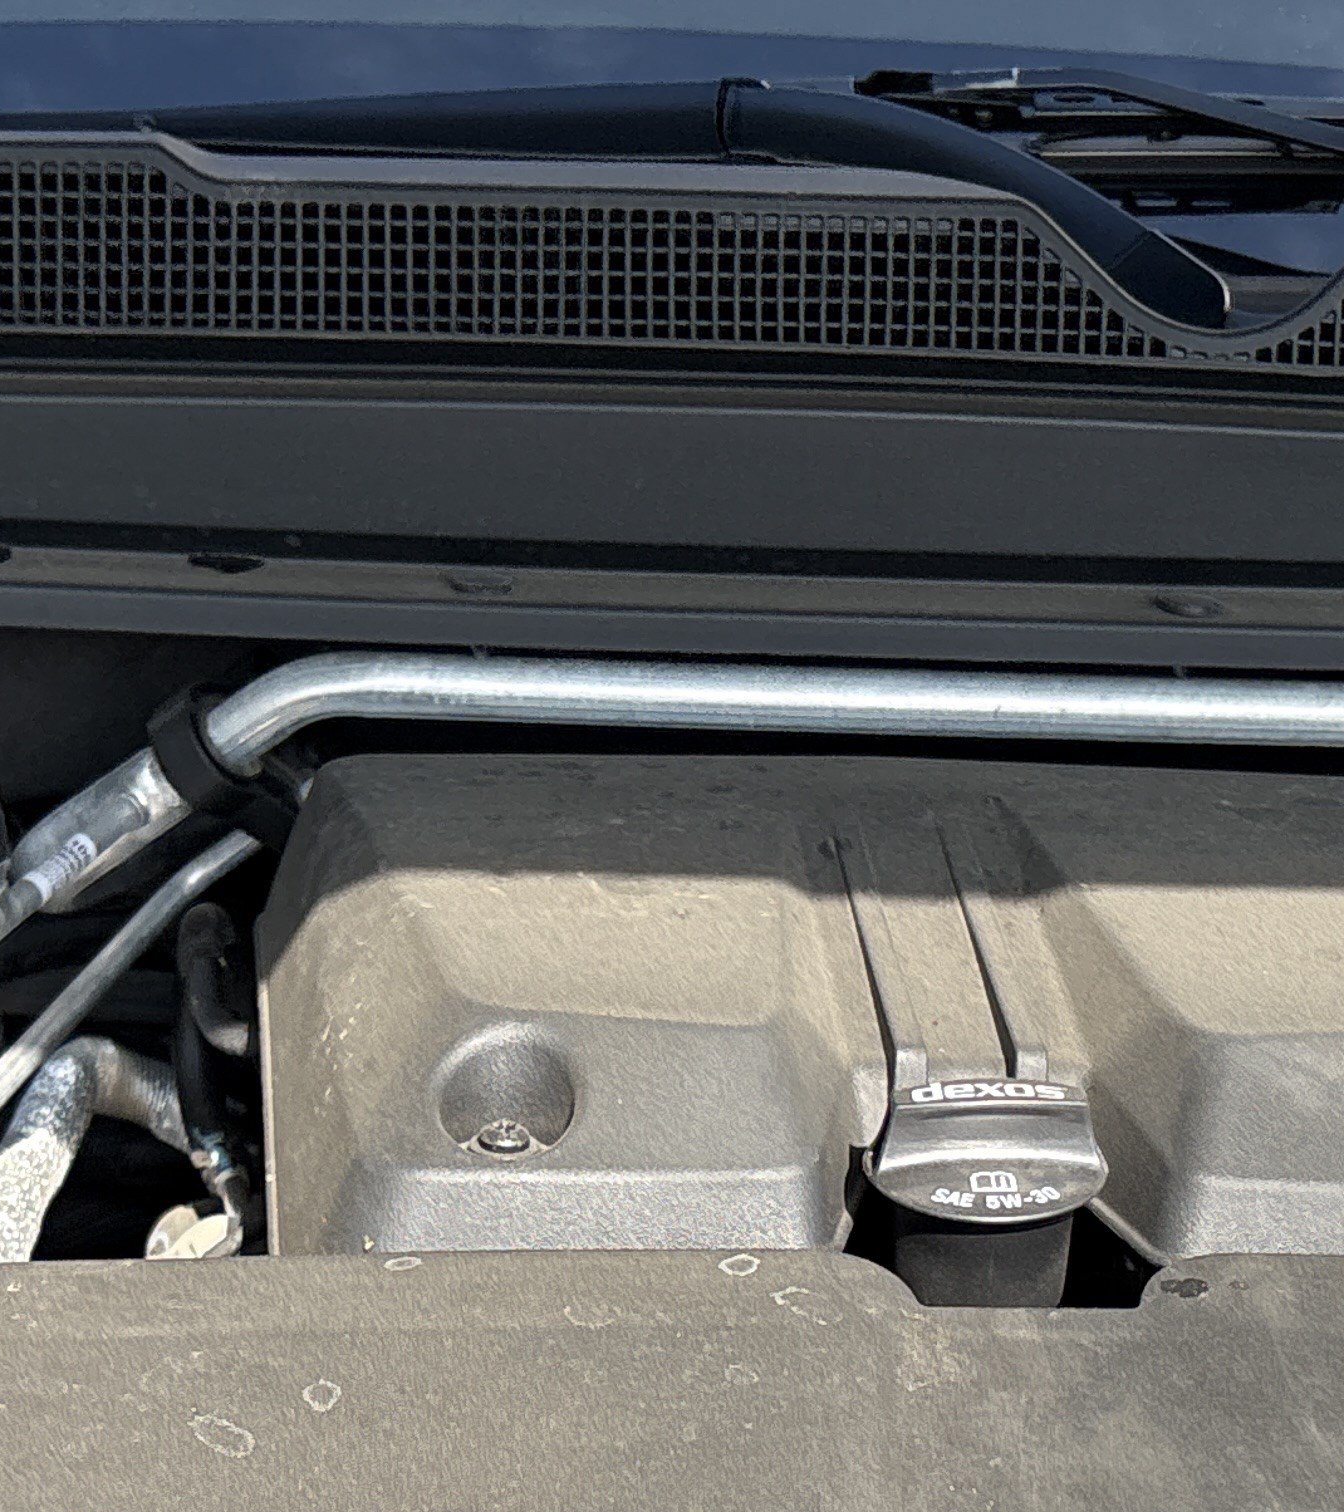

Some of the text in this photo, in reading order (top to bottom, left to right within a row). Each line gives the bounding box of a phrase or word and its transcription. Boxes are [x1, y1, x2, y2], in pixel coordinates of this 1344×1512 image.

[911, 1082, 1066, 1102] dexos
[931, 1186, 1061, 1209] SAE 5W-30
